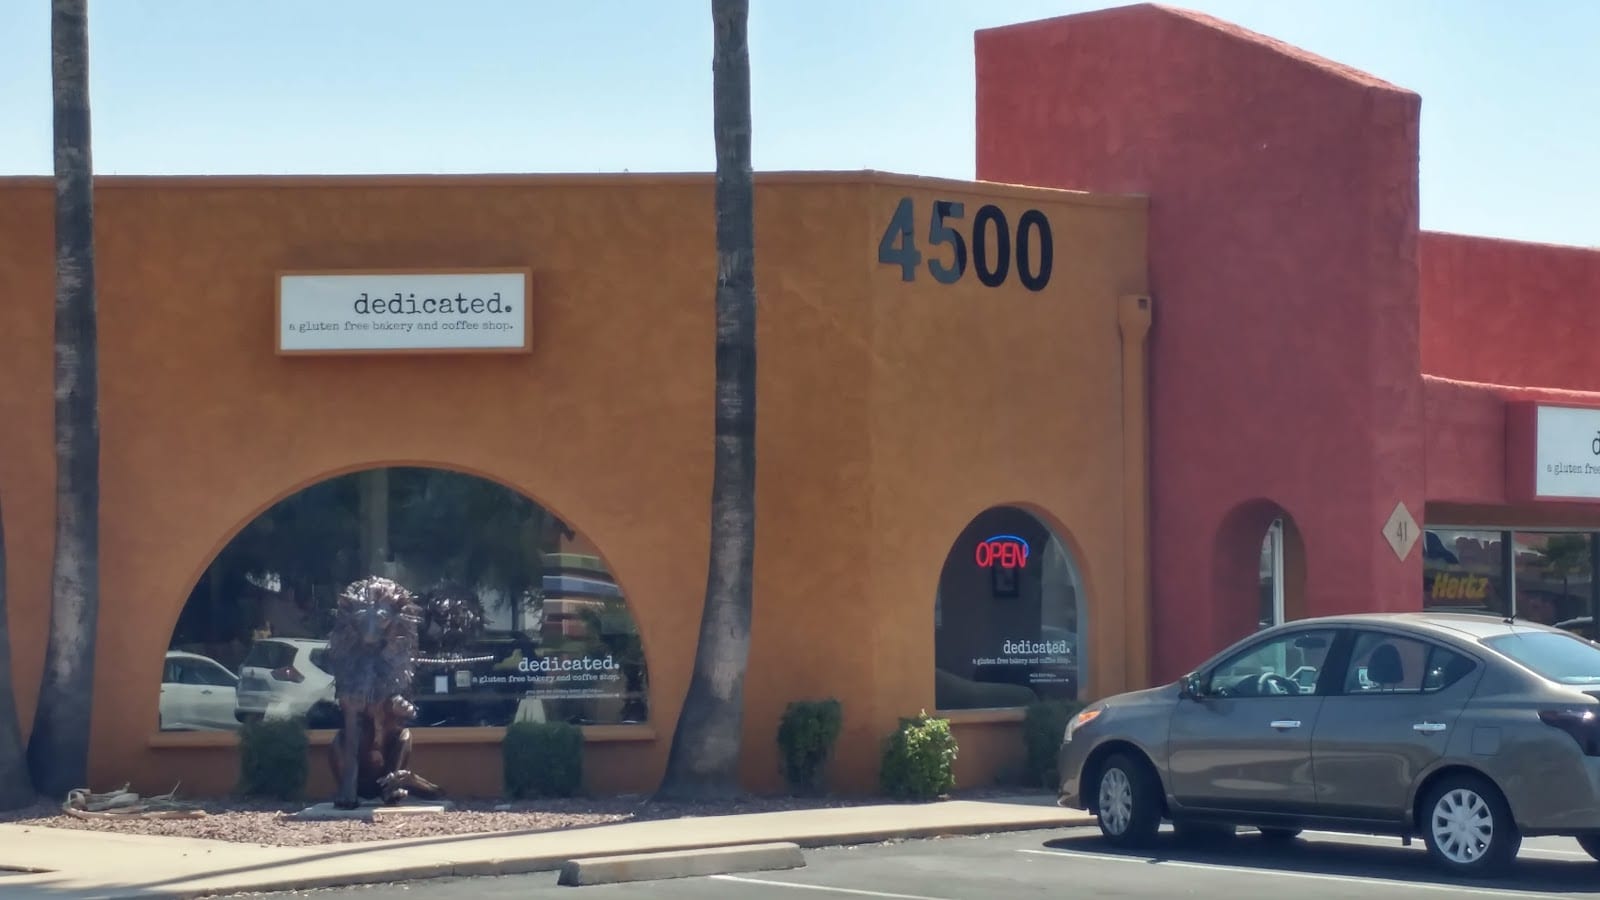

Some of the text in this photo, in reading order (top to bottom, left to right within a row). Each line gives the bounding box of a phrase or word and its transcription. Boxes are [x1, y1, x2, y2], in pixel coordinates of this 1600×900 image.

[878, 197, 1053, 292] 4500
[353, 293, 513, 315] dedicated.
[288, 320, 514, 334] a gluten free bakery and coffee shop.
[1546, 464, 1552, 472] a
[1554, 462, 1583, 476] gluten
[1396, 521, 1408, 542] 41
[975, 541, 1027, 568] OPEN
[1432, 572, 1489, 599] Hertz
[1003, 640, 1071, 654] dedicated.
[518, 656, 620, 672] dedicated.
[479, 675, 506, 683] gluten
[527, 674, 554, 683] bakery
